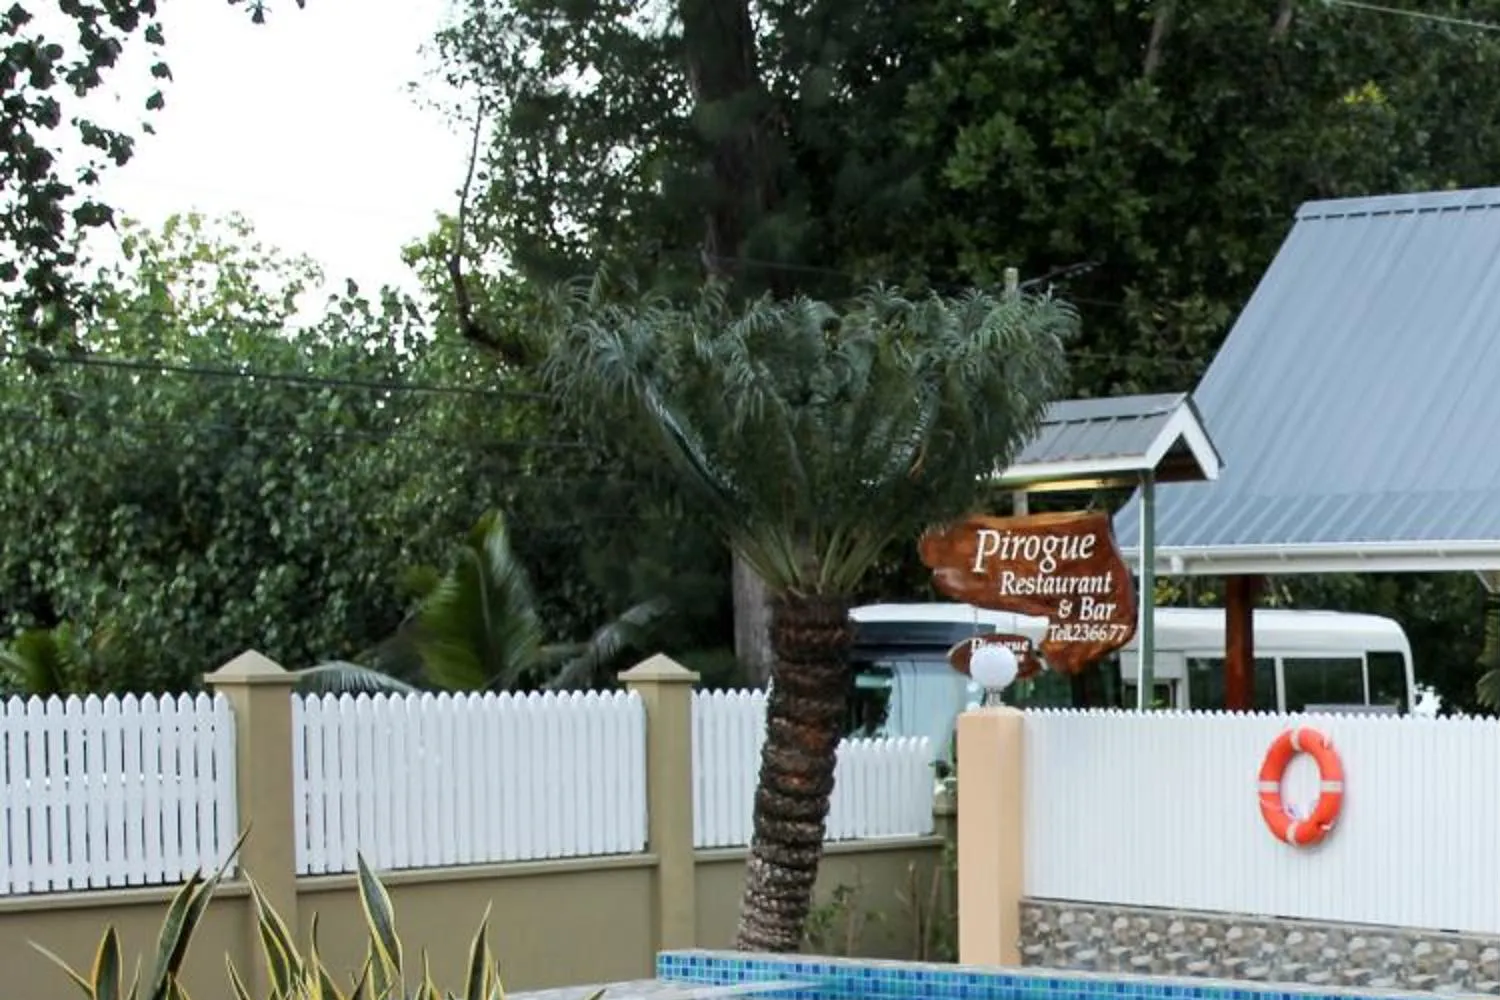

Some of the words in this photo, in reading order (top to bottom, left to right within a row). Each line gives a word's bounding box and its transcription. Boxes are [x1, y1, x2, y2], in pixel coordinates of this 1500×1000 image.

[972, 529, 1096, 573] Pirogue
[1000, 571, 1112, 595] Restaurant
[1058, 599, 1073, 619] &
[1079, 596, 1117, 621] Bar
